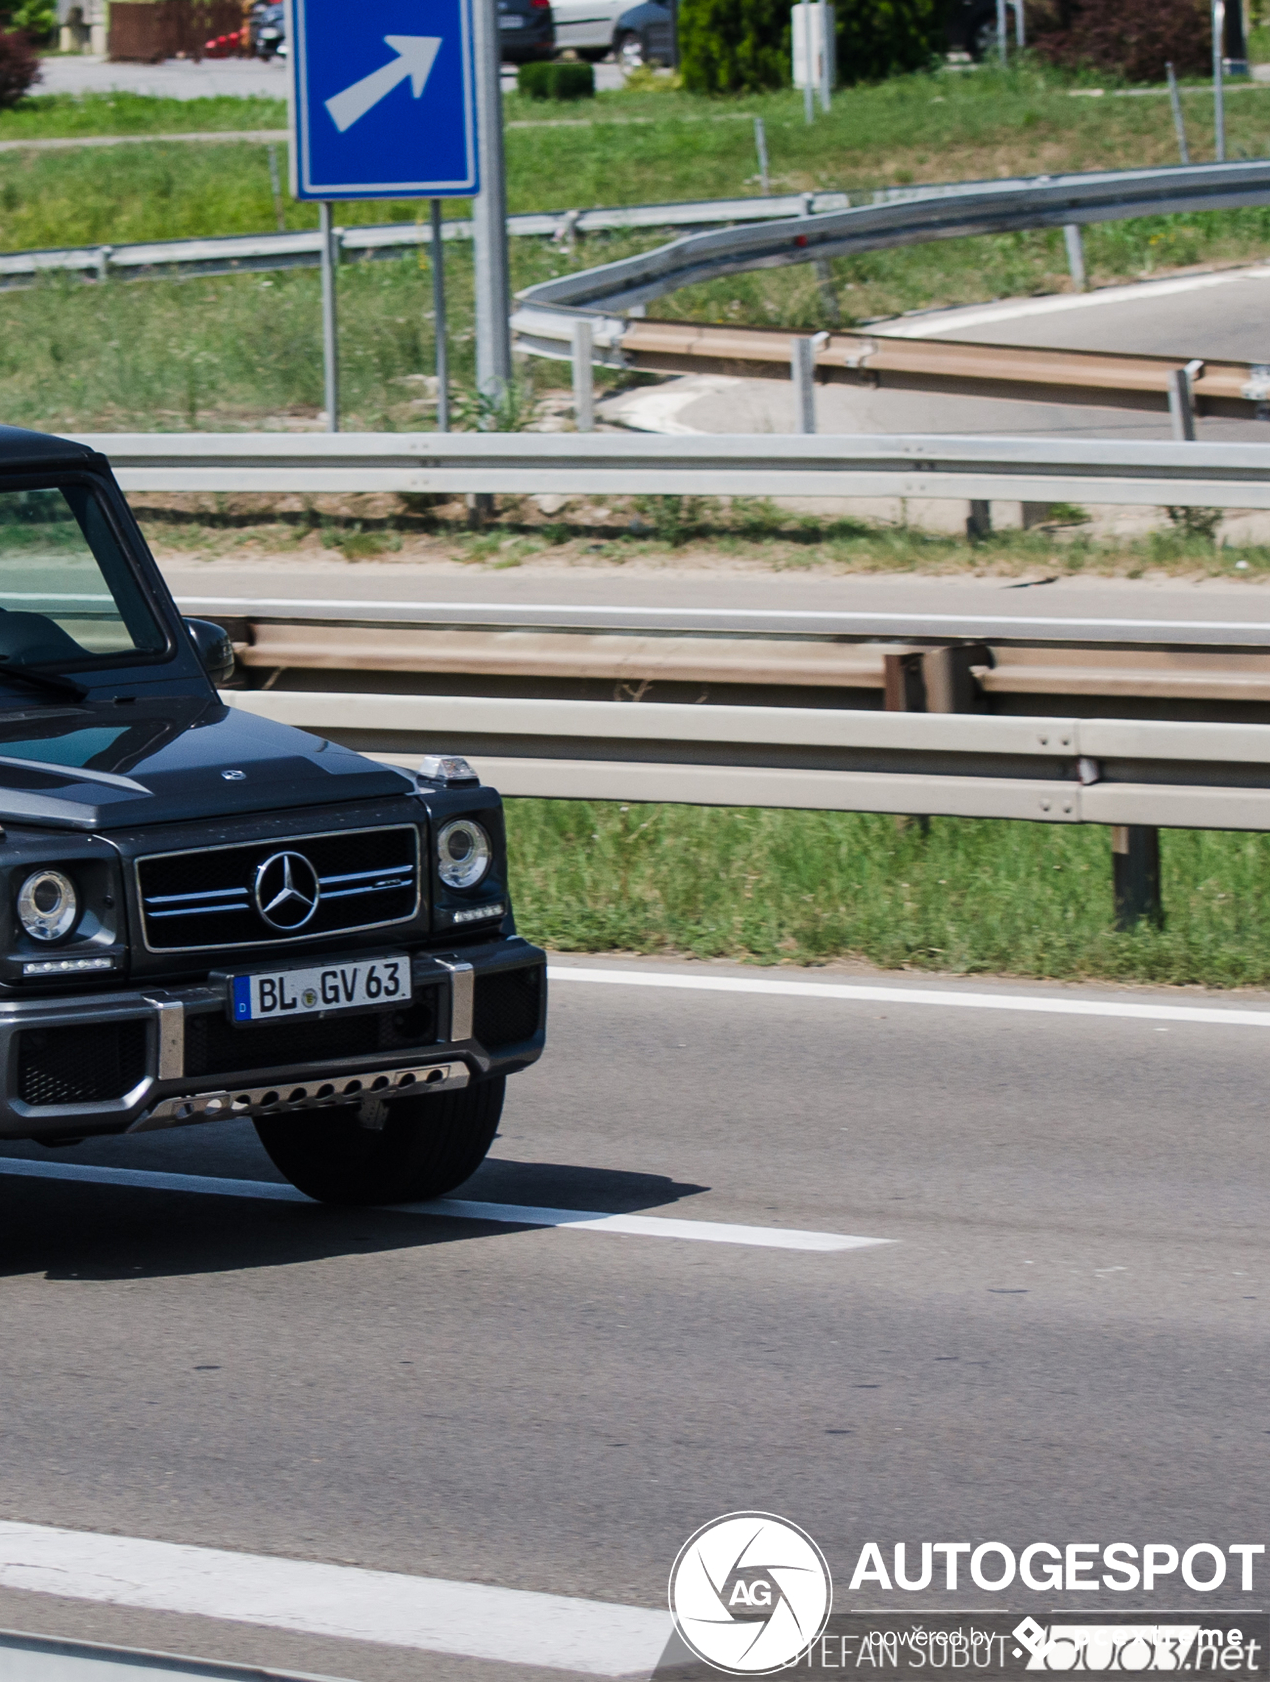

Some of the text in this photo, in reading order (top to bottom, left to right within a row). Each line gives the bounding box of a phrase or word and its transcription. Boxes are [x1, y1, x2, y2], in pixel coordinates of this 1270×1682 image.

[259, 962, 399, 1013] BL GV 63
[239, 1003, 247, 1013] D
